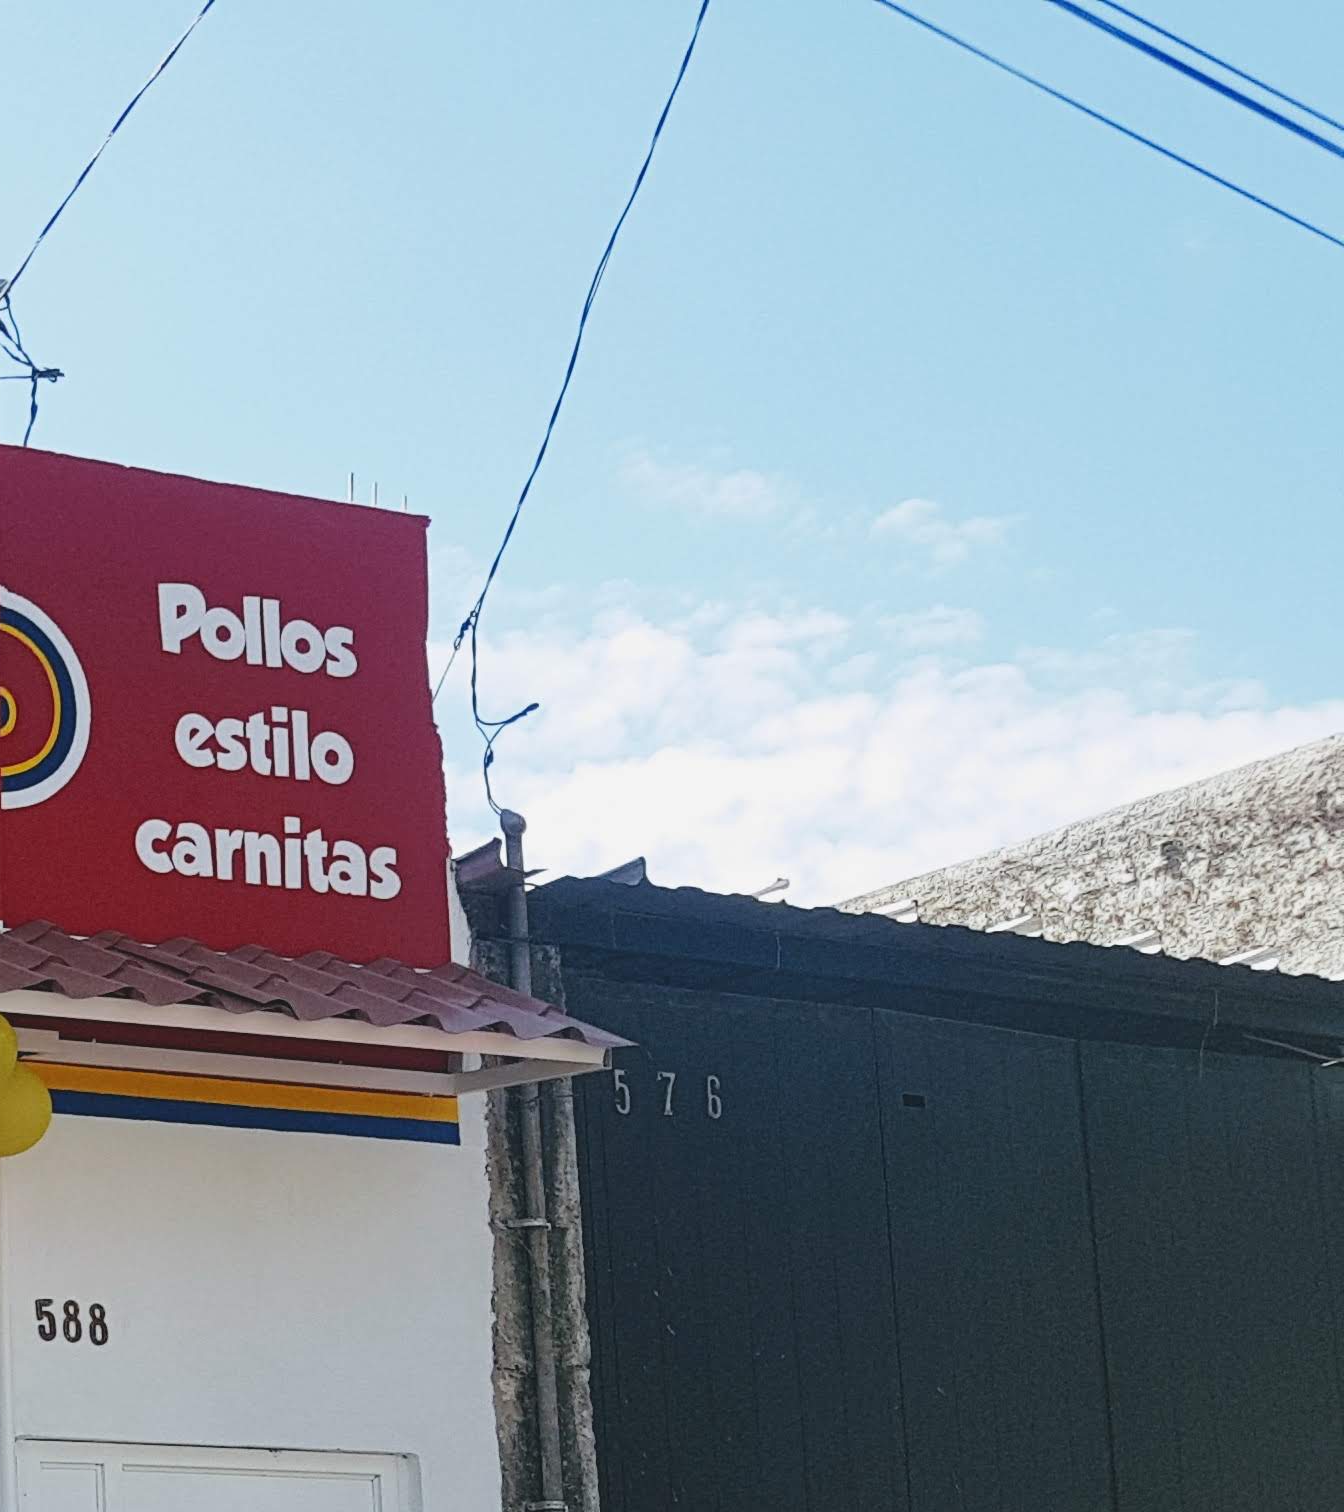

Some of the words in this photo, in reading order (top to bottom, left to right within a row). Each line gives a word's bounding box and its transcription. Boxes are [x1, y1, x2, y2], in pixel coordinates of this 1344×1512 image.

[157, 582, 359, 679] Pollos
[174, 705, 355, 786] estilo
[134, 815, 403, 901] carnitas
[34, 1298, 109, 1347] 588
